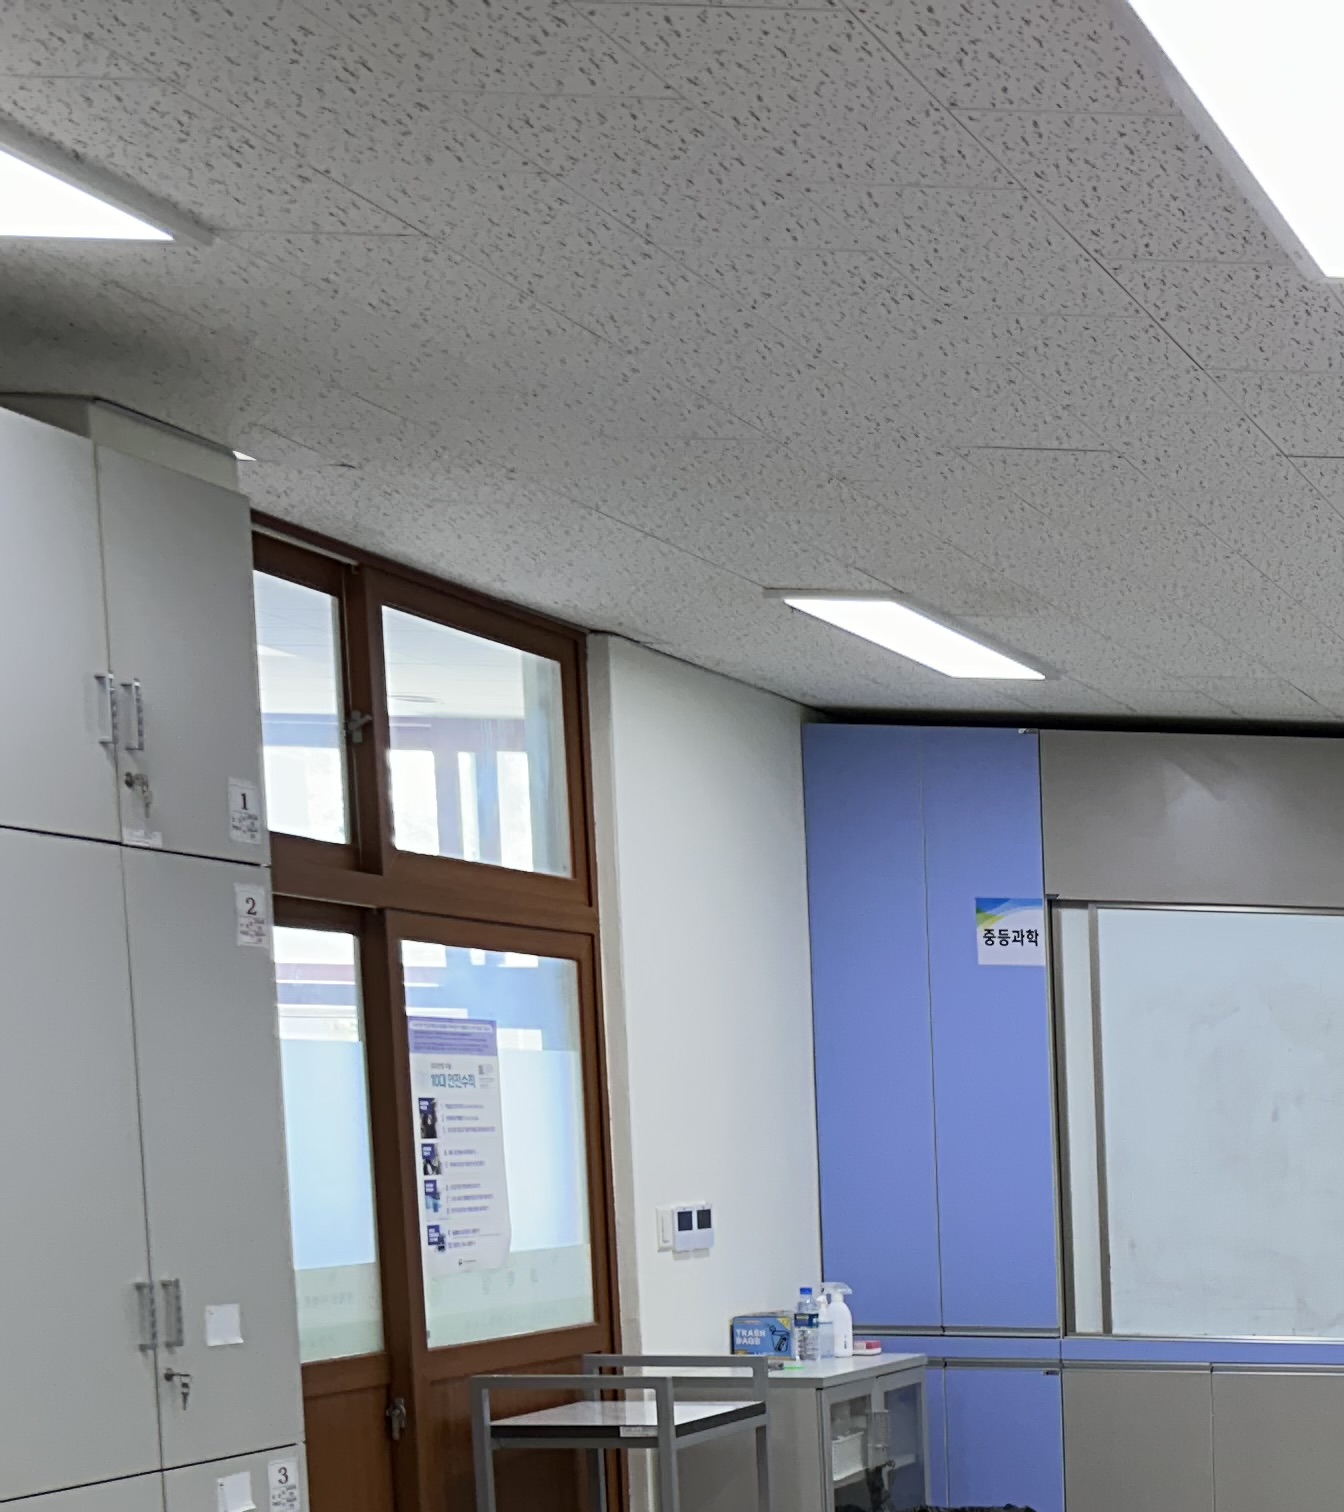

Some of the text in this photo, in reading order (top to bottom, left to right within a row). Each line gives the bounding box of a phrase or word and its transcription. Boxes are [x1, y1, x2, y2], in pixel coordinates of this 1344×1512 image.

[241, 793, 248, 810] 1
[246, 897, 256, 915] 2
[983, 929, 1039, 946] 중등과학
[735, 1328, 766, 1337] TRASH
[735, 1337, 761, 1345] BAGS
[277, 1466, 288, 1485] 3
